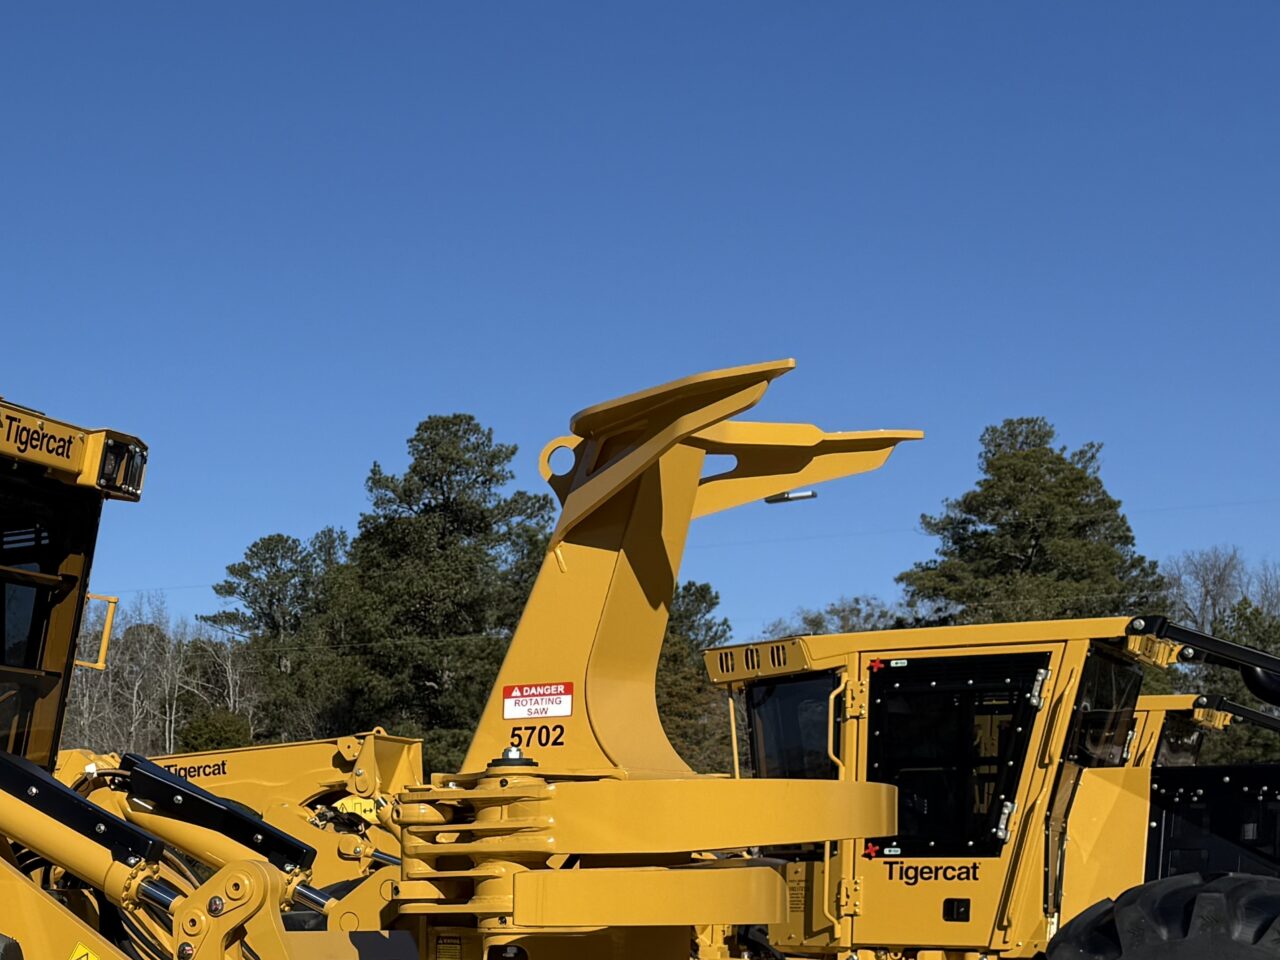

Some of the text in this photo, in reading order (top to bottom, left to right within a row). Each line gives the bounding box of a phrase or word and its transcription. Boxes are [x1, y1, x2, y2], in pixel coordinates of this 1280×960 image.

[5, 414, 73, 459] Tigercat
[523, 685, 564, 696] DANGER
[514, 697, 562, 707] ROTATING
[527, 708, 548, 716] SAW
[510, 724, 565, 748] 5702
[883, 860, 980, 886] Tigercat
